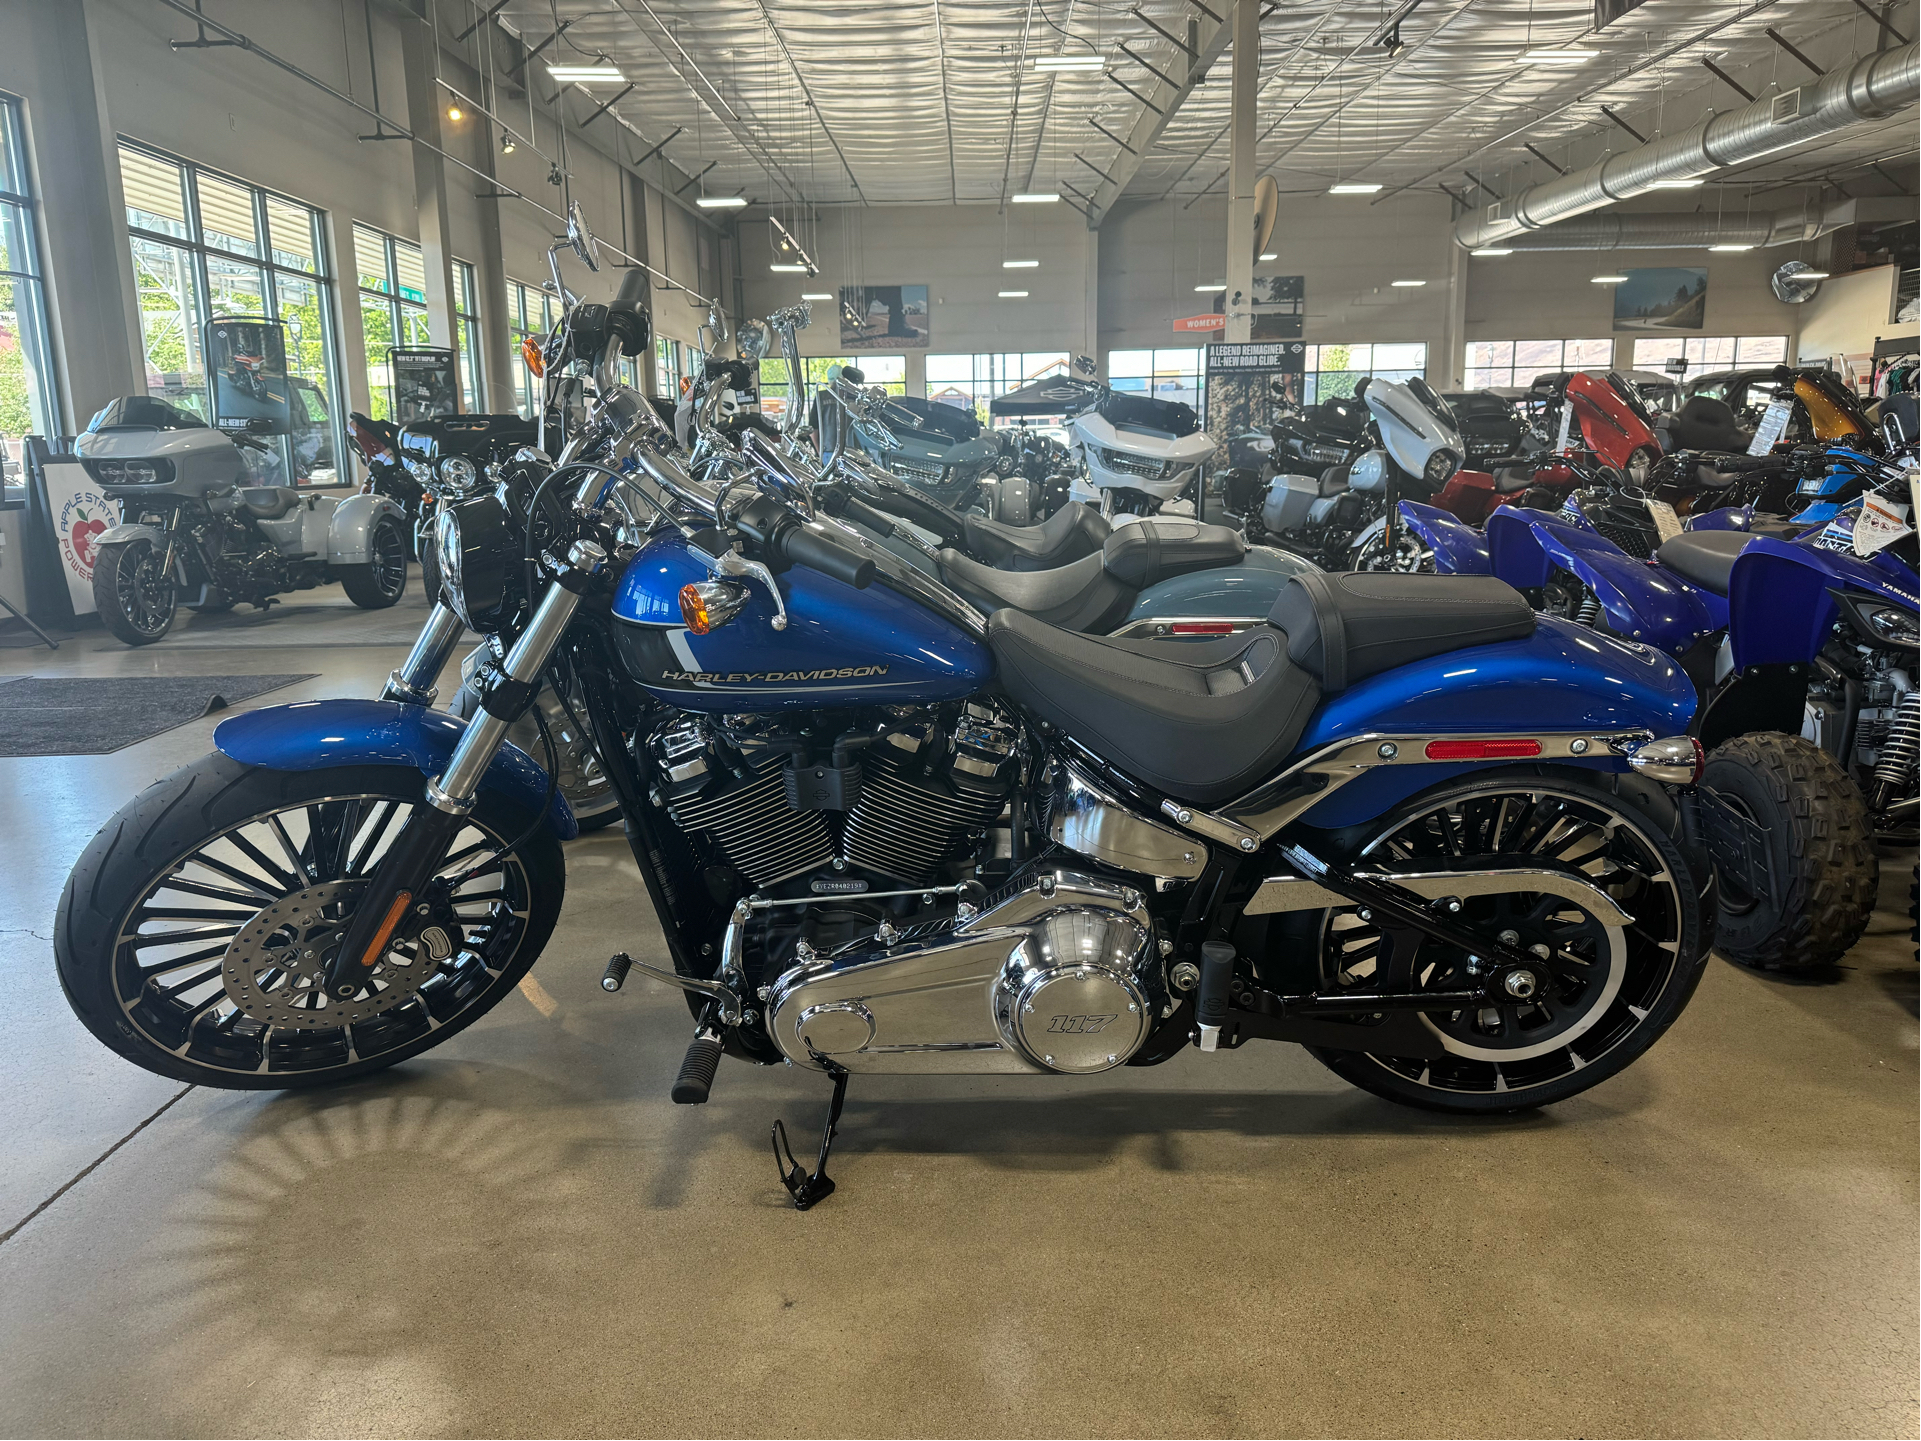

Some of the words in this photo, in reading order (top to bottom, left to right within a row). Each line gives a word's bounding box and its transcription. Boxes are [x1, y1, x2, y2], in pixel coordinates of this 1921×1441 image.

[1187, 318, 1224, 328] WOMEN'S
[1209, 346, 1215, 356] A
[1215, 345, 1241, 356] LEGEND
[1242, 344, 1286, 355] REIMAGINED.
[1209, 356, 1239, 367] ALL-NEW
[1240, 356, 1257, 366] ROAD
[1258, 355, 1281, 366] GLIDE.
[60, 492, 83, 533] APPLE
[85, 492, 118, 528] STATE
[1882, 581, 1921, 605] YAMAHA
[661, 664, 889, 683] HARLEY-DAVIDSON
[1046, 1014, 1118, 1034] 117
